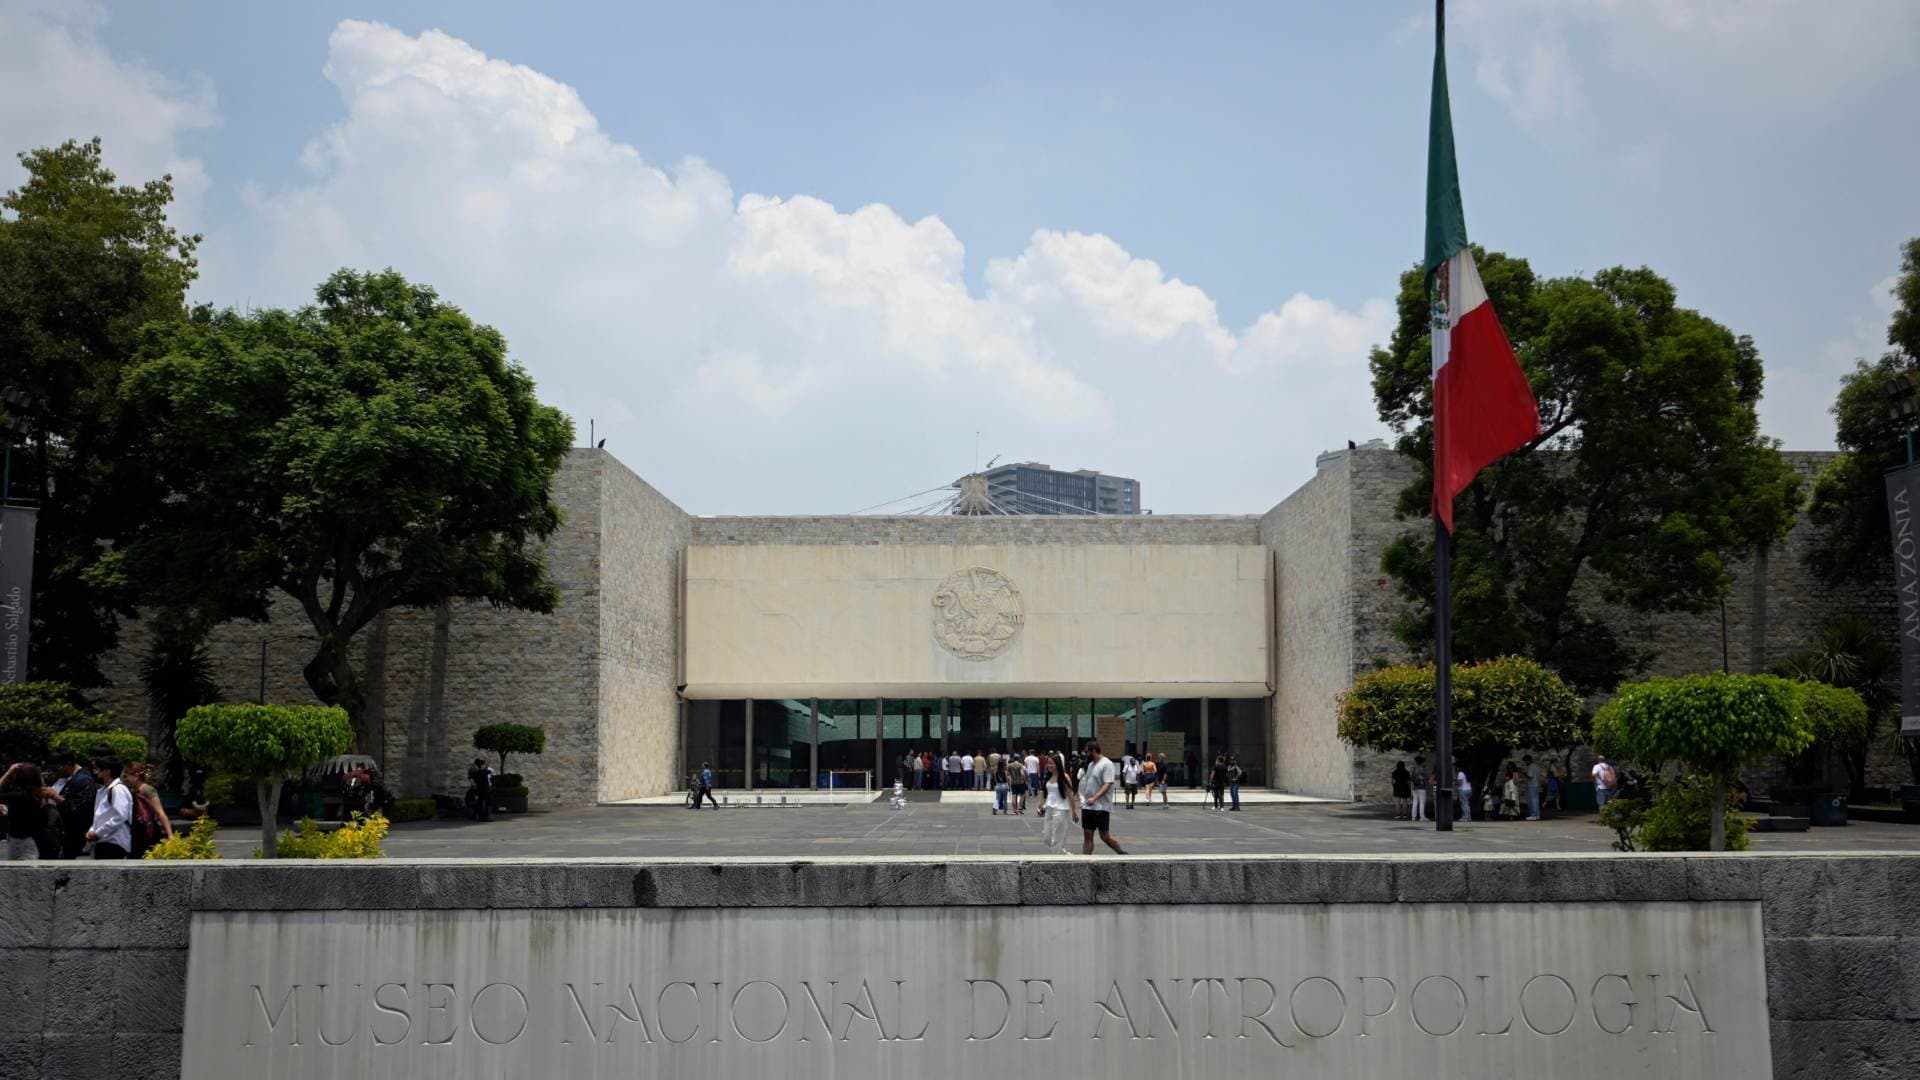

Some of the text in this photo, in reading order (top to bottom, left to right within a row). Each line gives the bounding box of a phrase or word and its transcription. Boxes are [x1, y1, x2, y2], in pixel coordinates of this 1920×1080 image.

[1893, 488, 1920, 641] AMAZÔNIA
[6, 586, 23, 631] Salgado
[241, 973, 1717, 1049] MUSEO NACIONAL DE ANTROPOLOGIA
